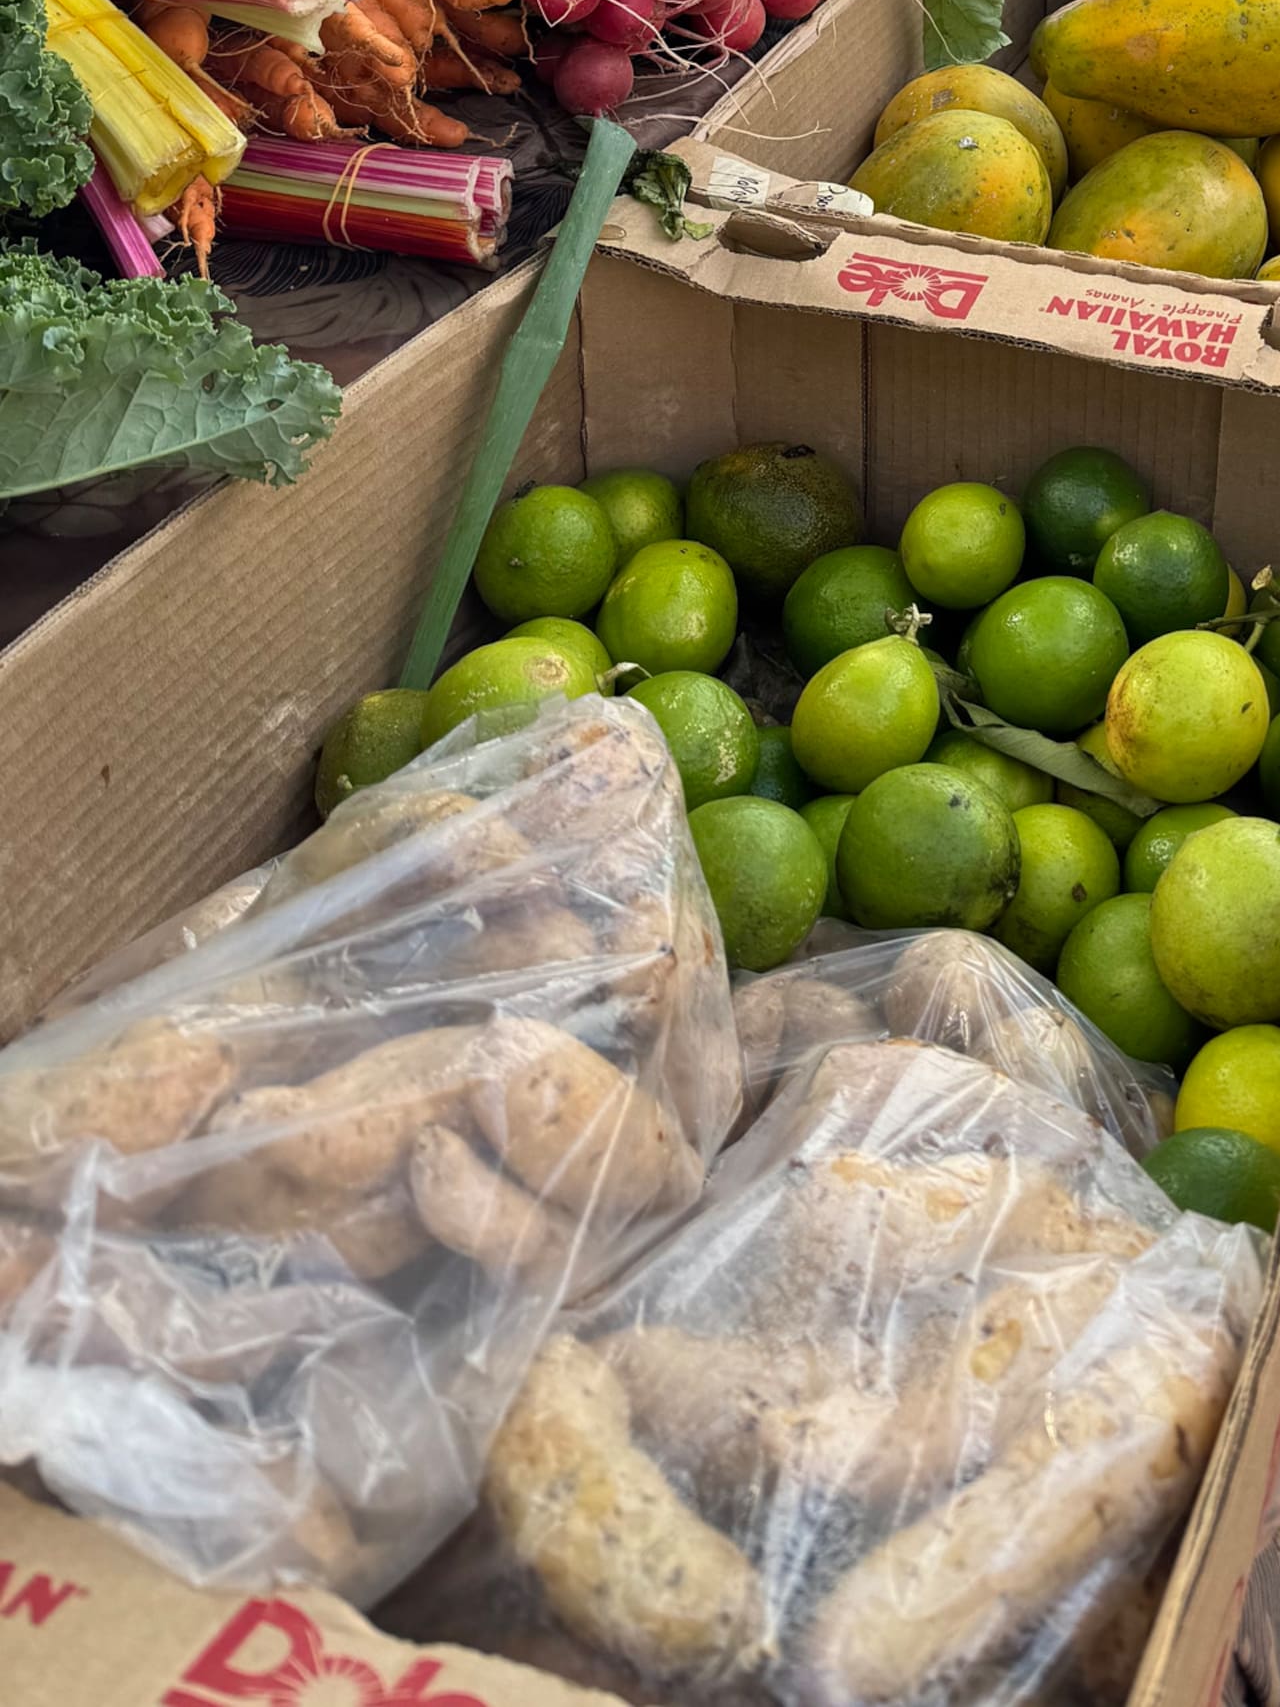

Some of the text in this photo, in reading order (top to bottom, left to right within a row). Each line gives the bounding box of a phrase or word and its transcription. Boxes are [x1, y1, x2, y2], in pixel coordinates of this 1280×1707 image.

[836, 256, 988, 320] Dole
[1084, 288, 1145, 310] Ananas
[1046, 296, 1239, 344] HAWAIIAN
[1162, 302, 1244, 325] Pineapple
[1112, 329, 1229, 368] ROYAL
